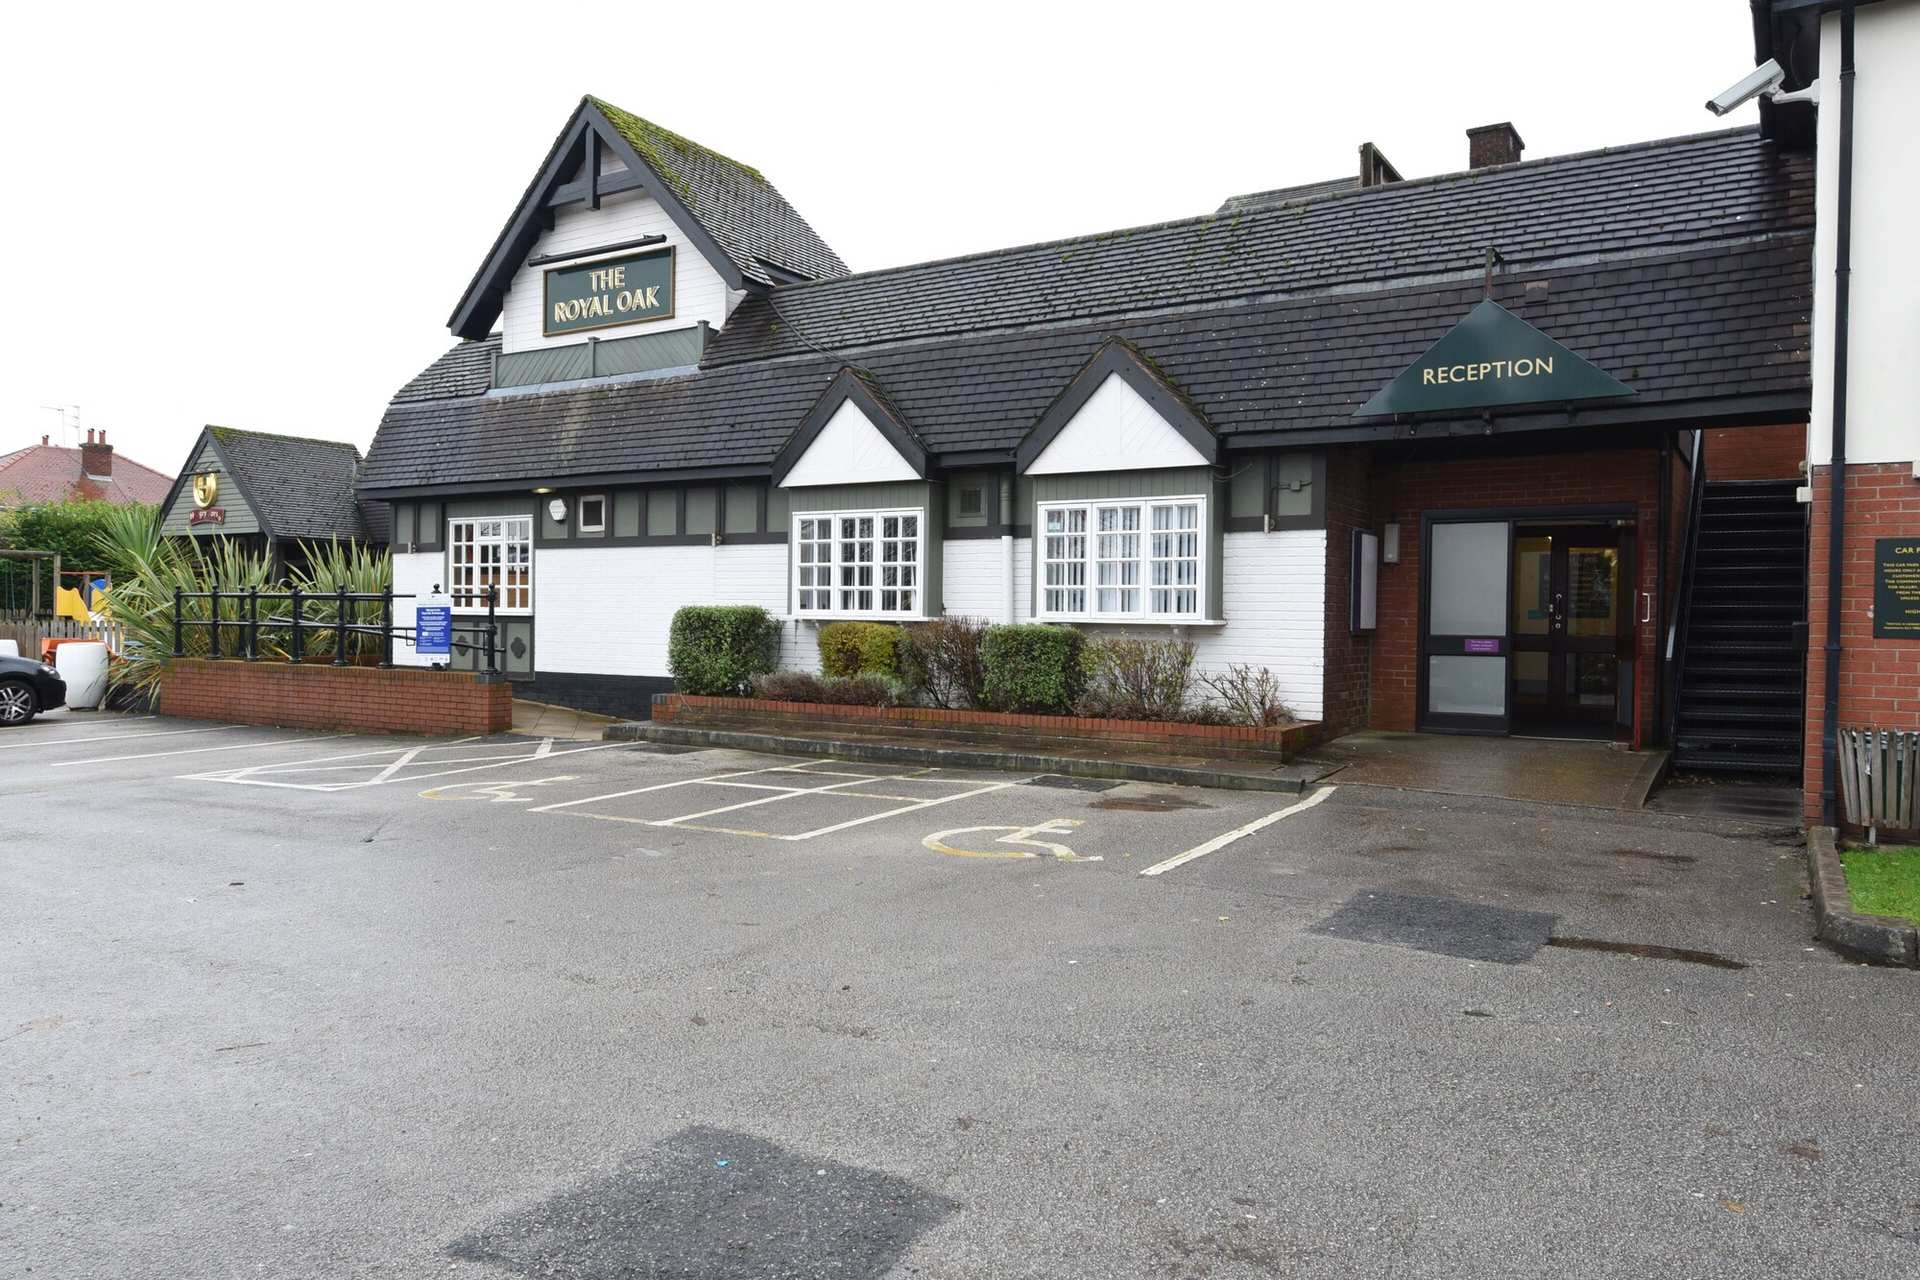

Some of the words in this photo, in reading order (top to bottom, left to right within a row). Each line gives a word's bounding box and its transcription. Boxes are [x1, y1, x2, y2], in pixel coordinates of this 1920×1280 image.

[589, 266, 625, 292] THE
[554, 294, 614, 323] ROYAL
[616, 285, 660, 313] OAK
[1423, 357, 1553, 385] RECEPTION
